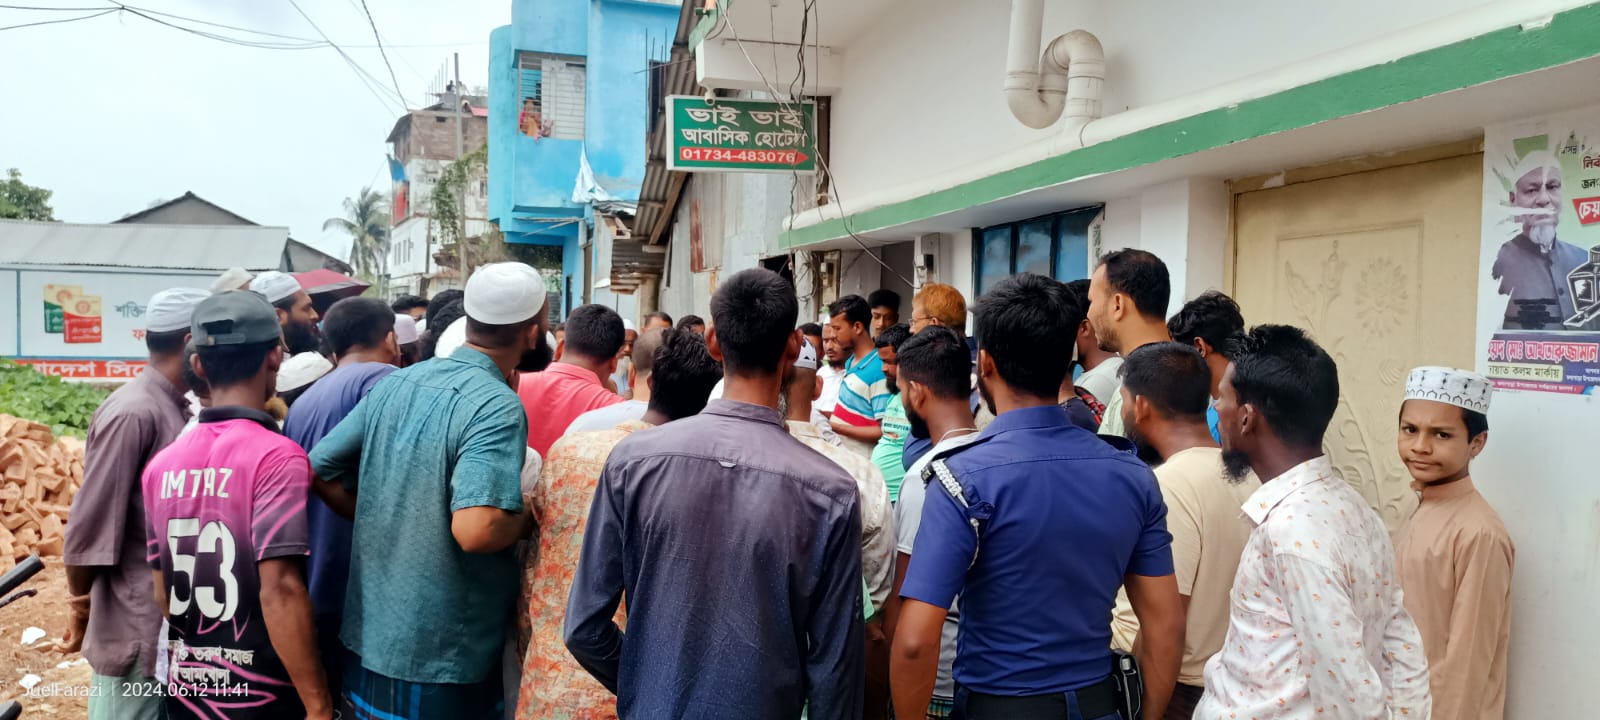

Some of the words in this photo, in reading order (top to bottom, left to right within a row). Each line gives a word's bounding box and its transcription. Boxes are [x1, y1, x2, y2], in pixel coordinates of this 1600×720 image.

[685, 106, 741, 127] ভাই
[748, 107, 804, 129] ভাই
[681, 125, 750, 145] আবাসিক
[682, 149, 796, 163] 01734-483076
[167, 518, 239, 622] 53
